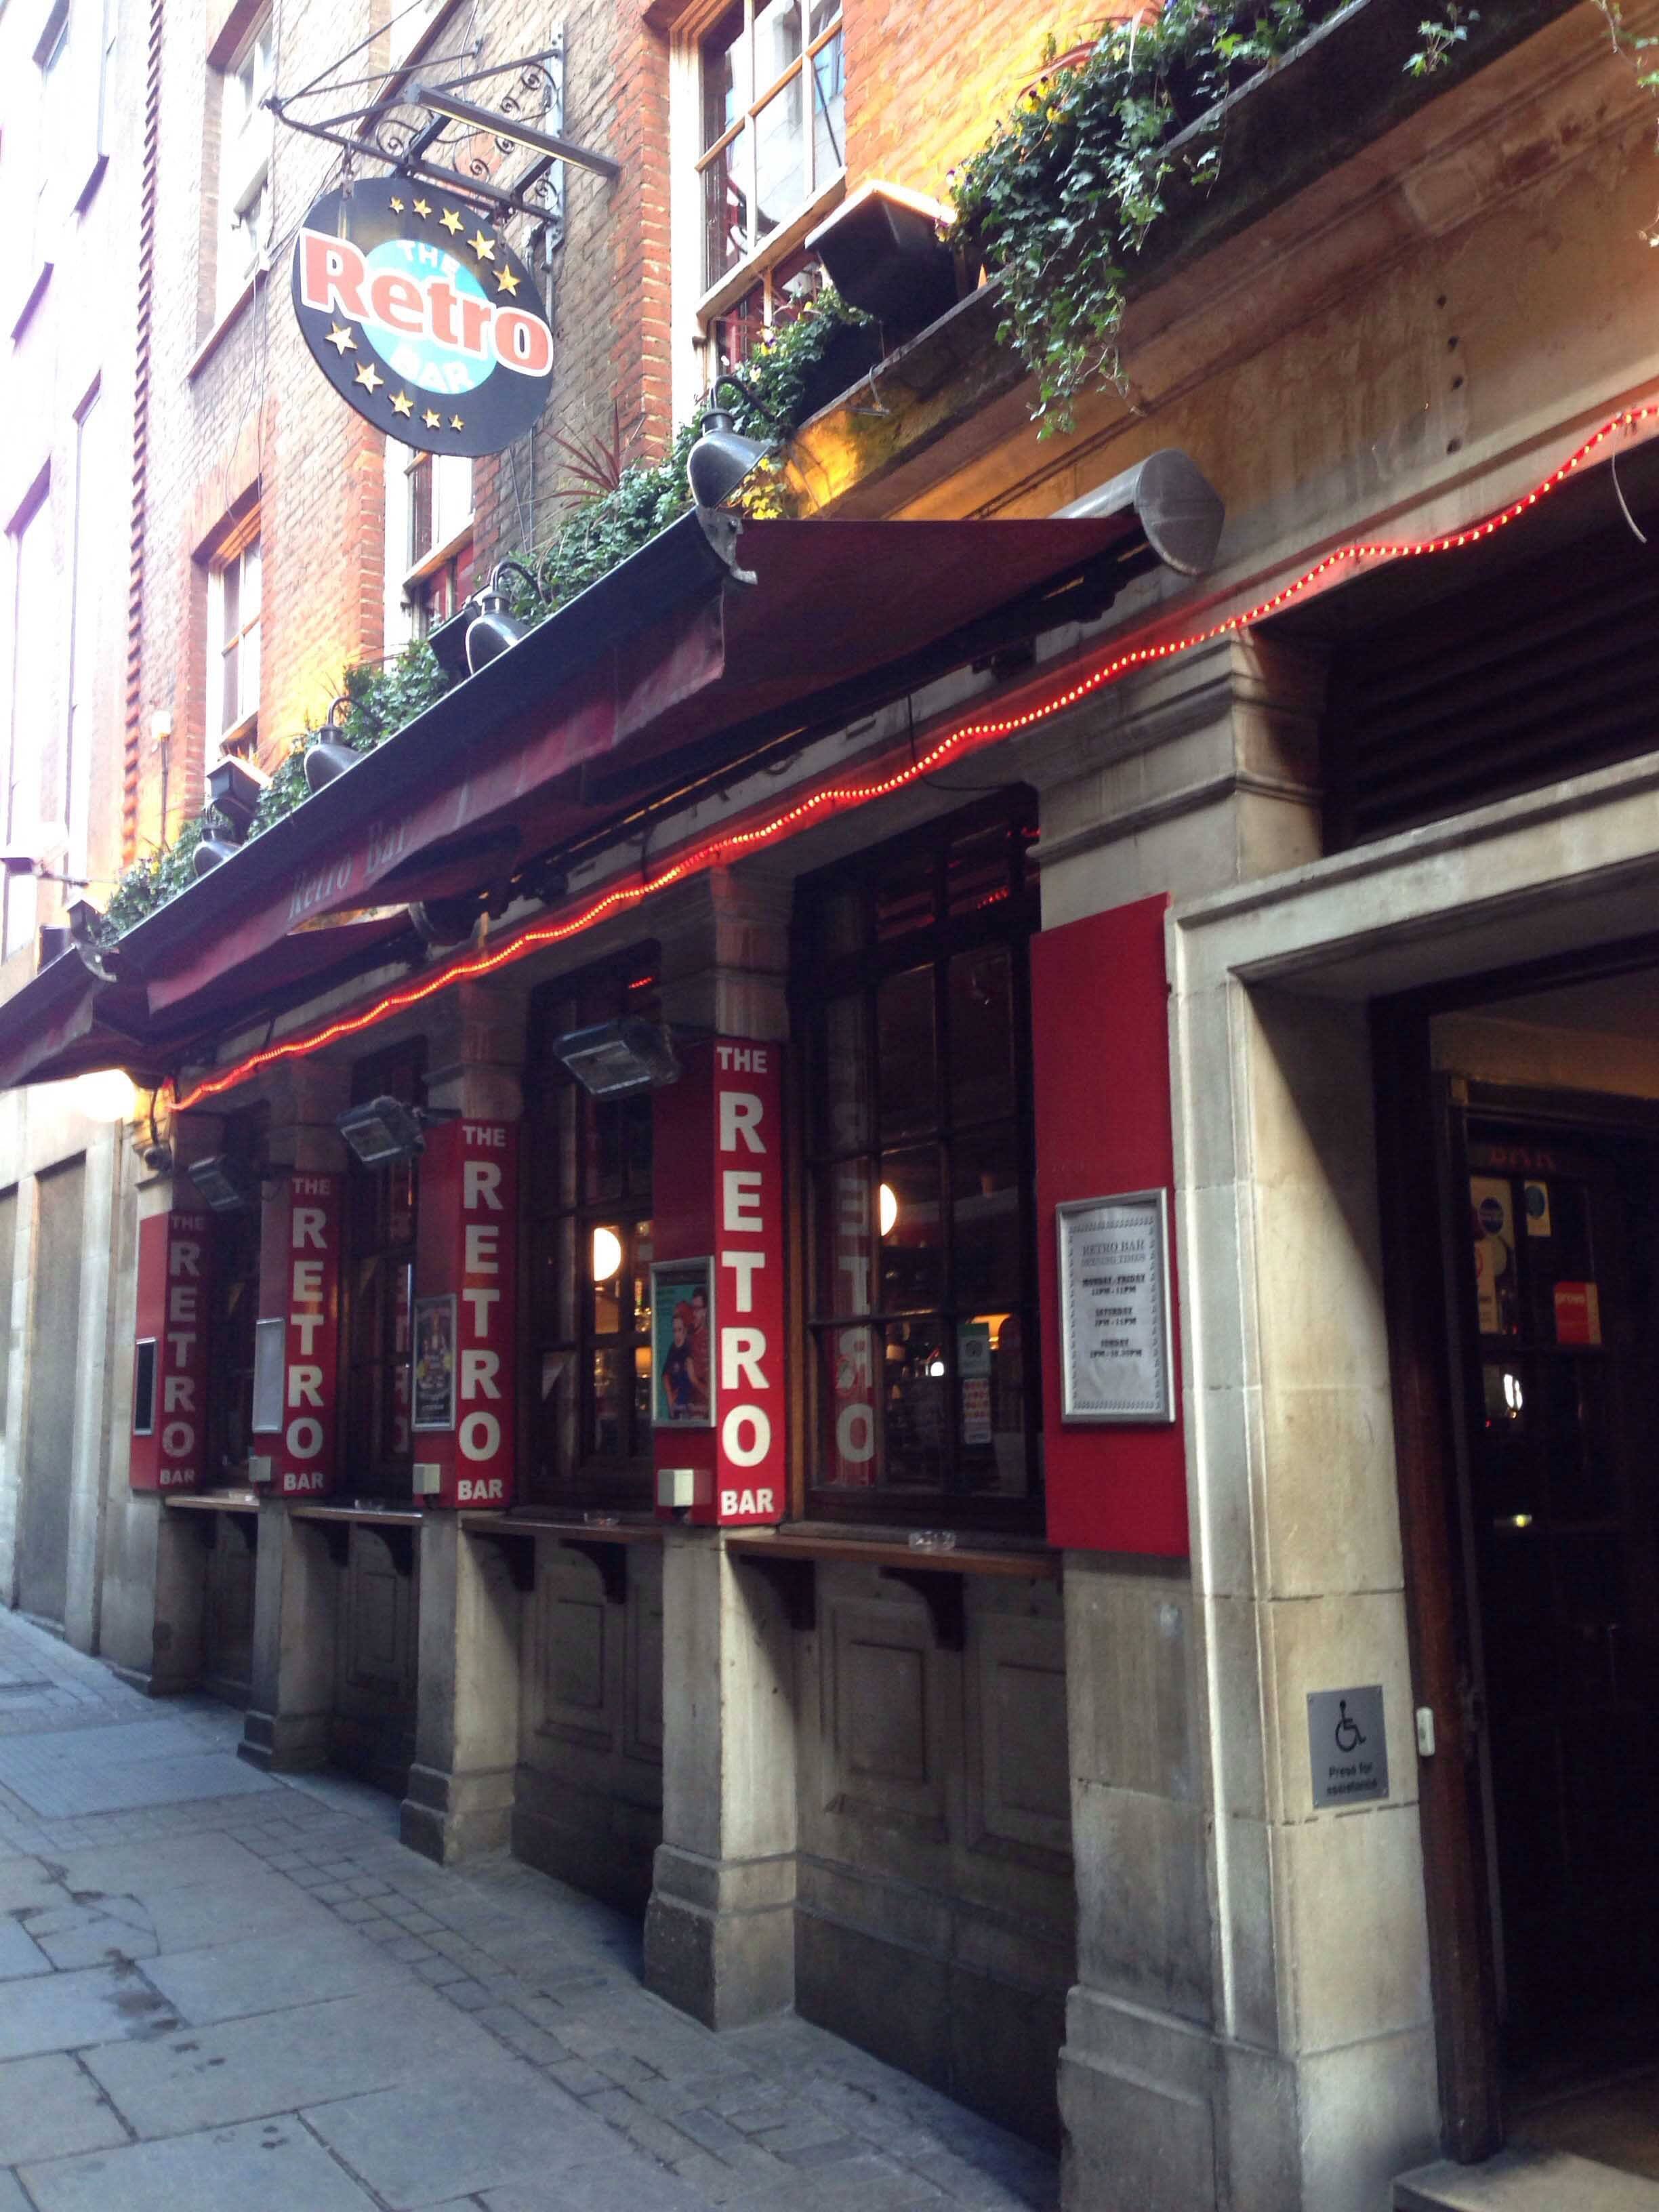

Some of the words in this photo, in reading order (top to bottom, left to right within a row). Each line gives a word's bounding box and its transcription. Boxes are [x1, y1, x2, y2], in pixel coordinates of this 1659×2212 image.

[397, 240, 460, 272] THE
[300, 227, 553, 377] Retro
[390, 343, 473, 393] BAR
[717, 1046, 768, 1074] THE
[462, 1125, 506, 1148] THE
[292, 1177, 331, 1197] THE
[1122, 1238, 1144, 1253] BAR
[719, 1090, 771, 1468] RETRO
[459, 1160, 504, 1462] RETRO
[285, 1207, 327, 1460] RETRO
[162, 1241, 200, 1457] RETRO
[159, 1468, 194, 1486] BAR
[283, 1473, 324, 1492] BAR
[457, 1479, 504, 1502] BAR
[720, 1488, 774, 1517] BAR
